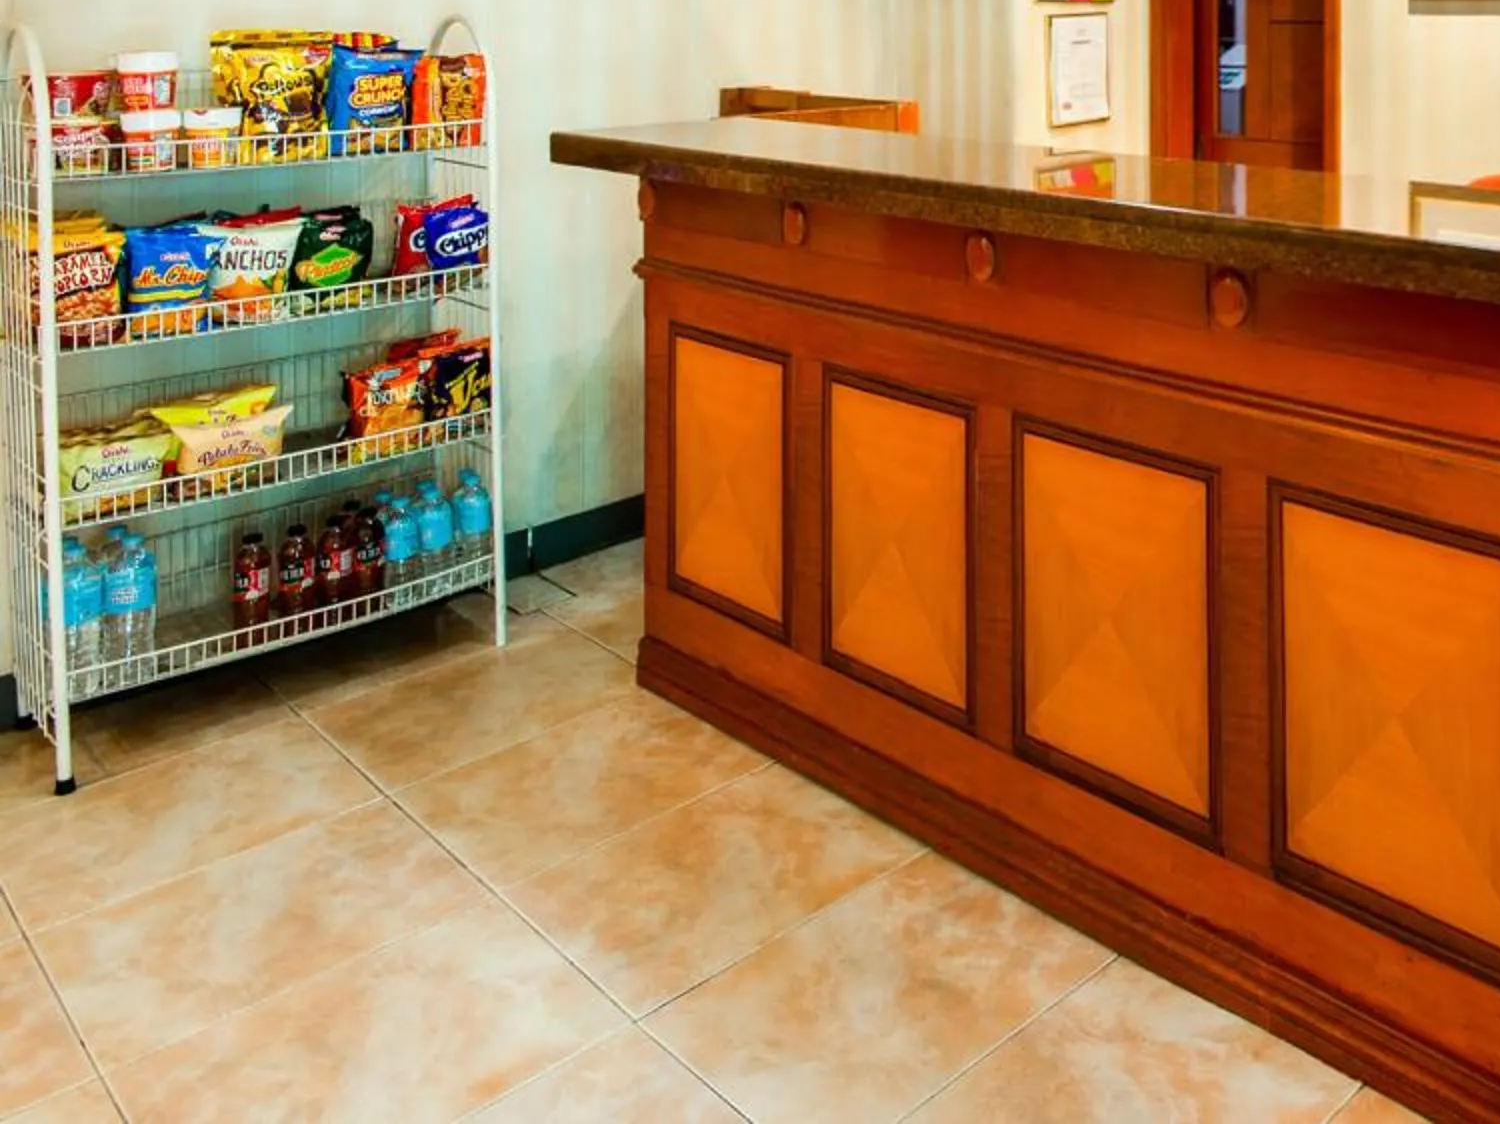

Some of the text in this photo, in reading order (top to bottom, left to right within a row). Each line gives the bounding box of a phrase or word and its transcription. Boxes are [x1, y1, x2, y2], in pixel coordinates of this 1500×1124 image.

[358, 75, 403, 92] SUPER
[352, 89, 405, 106] CRUNC
[164, 264, 206, 286] Chip
